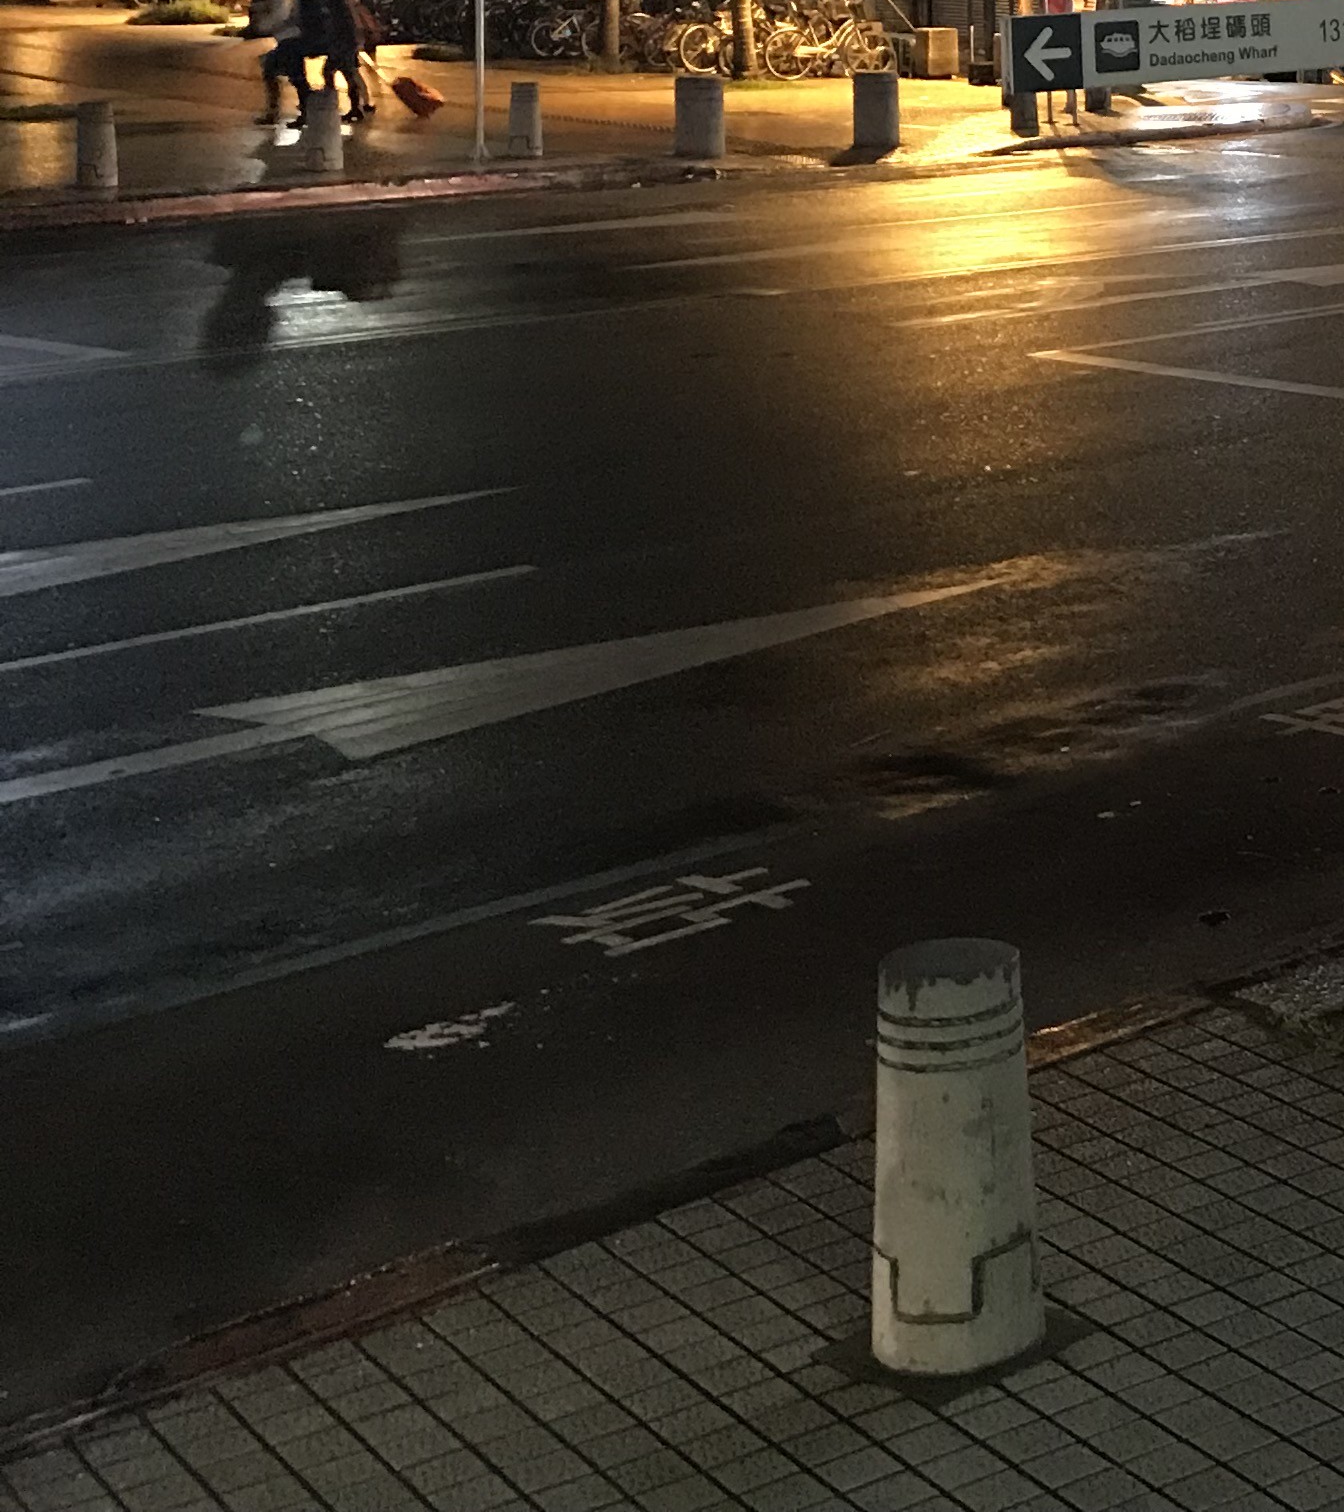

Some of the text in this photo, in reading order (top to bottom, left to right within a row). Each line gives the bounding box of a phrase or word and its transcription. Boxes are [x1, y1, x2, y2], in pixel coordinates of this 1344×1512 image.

[1148, 14, 1272, 44] 大稻埕碼頭
[1150, 45, 1278, 66] Dadaocheng Wharf
